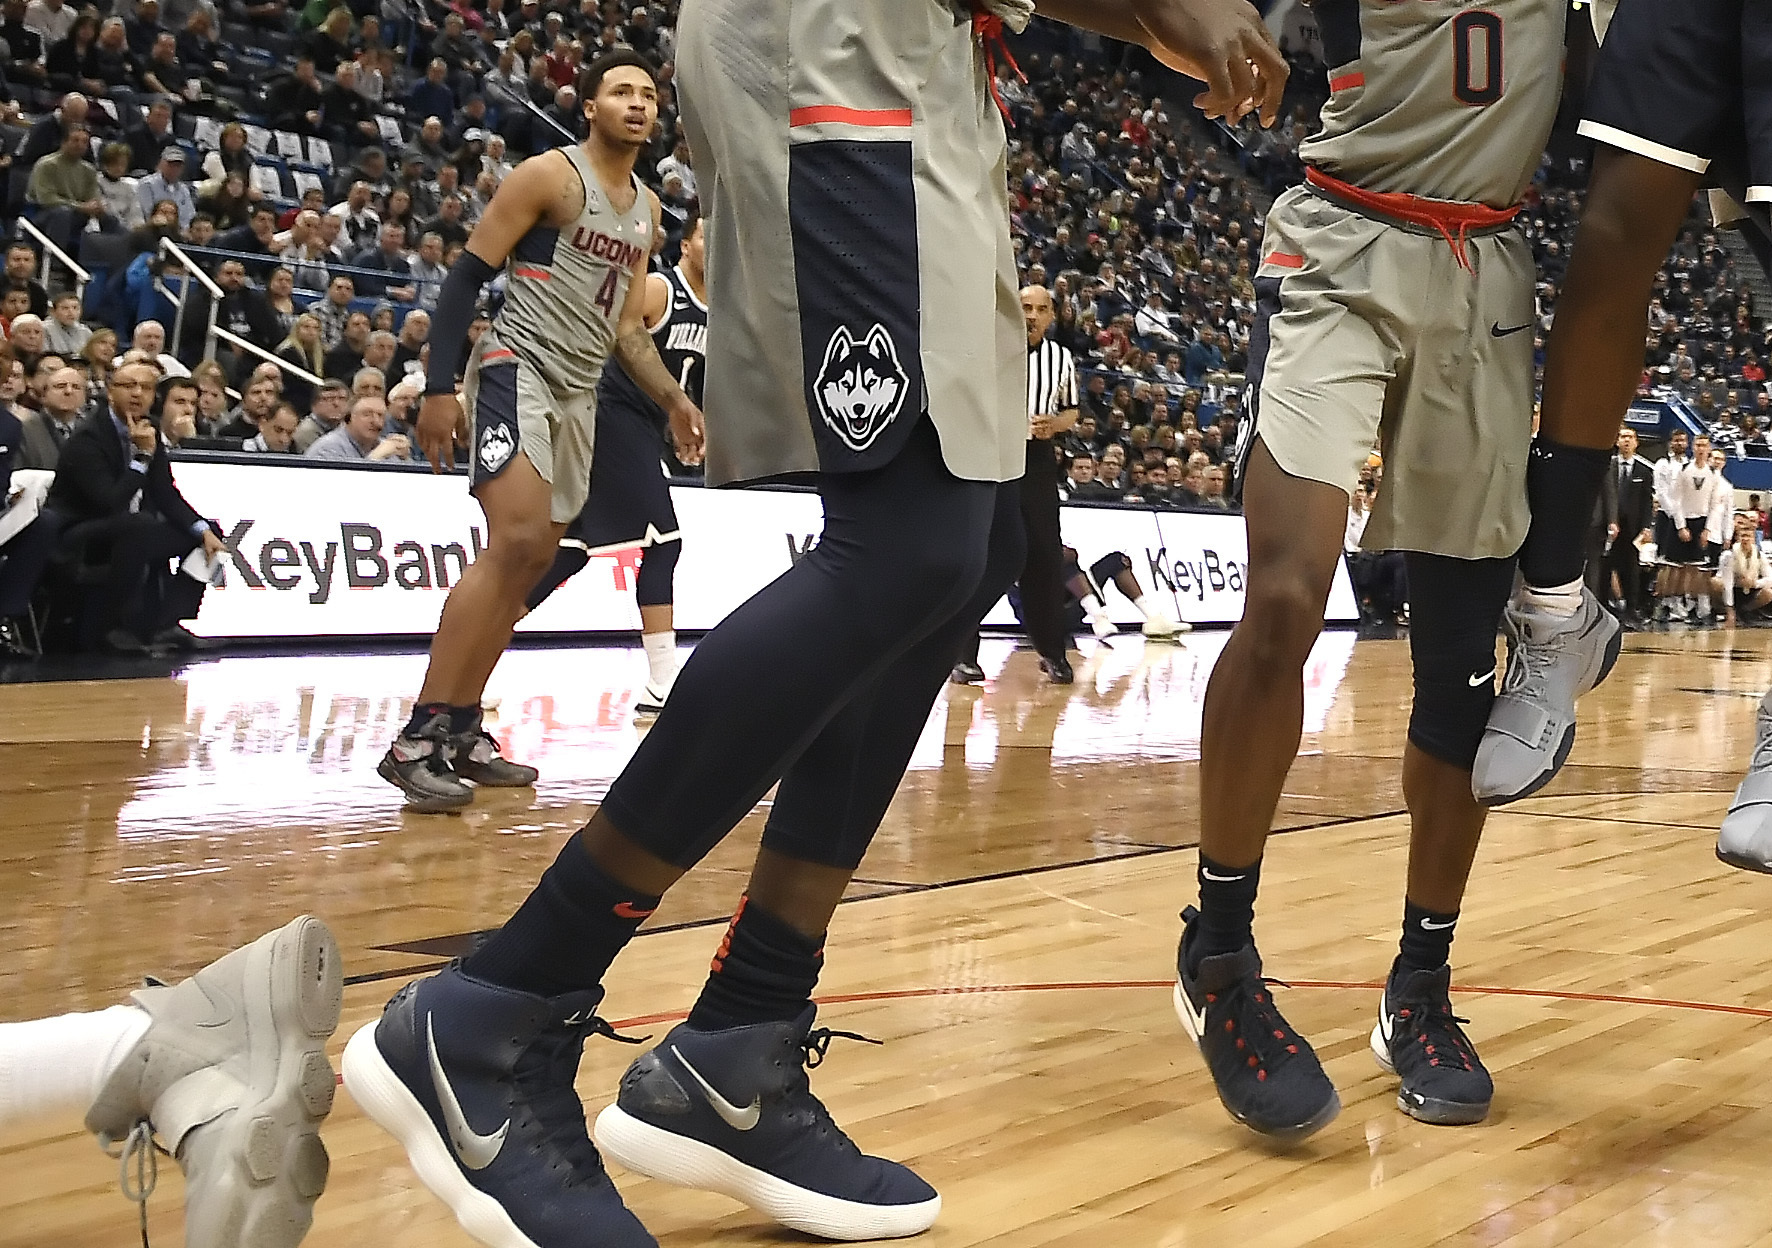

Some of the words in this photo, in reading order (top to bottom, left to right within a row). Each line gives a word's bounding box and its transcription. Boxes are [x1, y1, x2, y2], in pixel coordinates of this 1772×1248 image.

[1452, 8, 1504, 107] 0
[594, 265, 620, 318] 4
[1145, 547, 1249, 601] KeyBa
